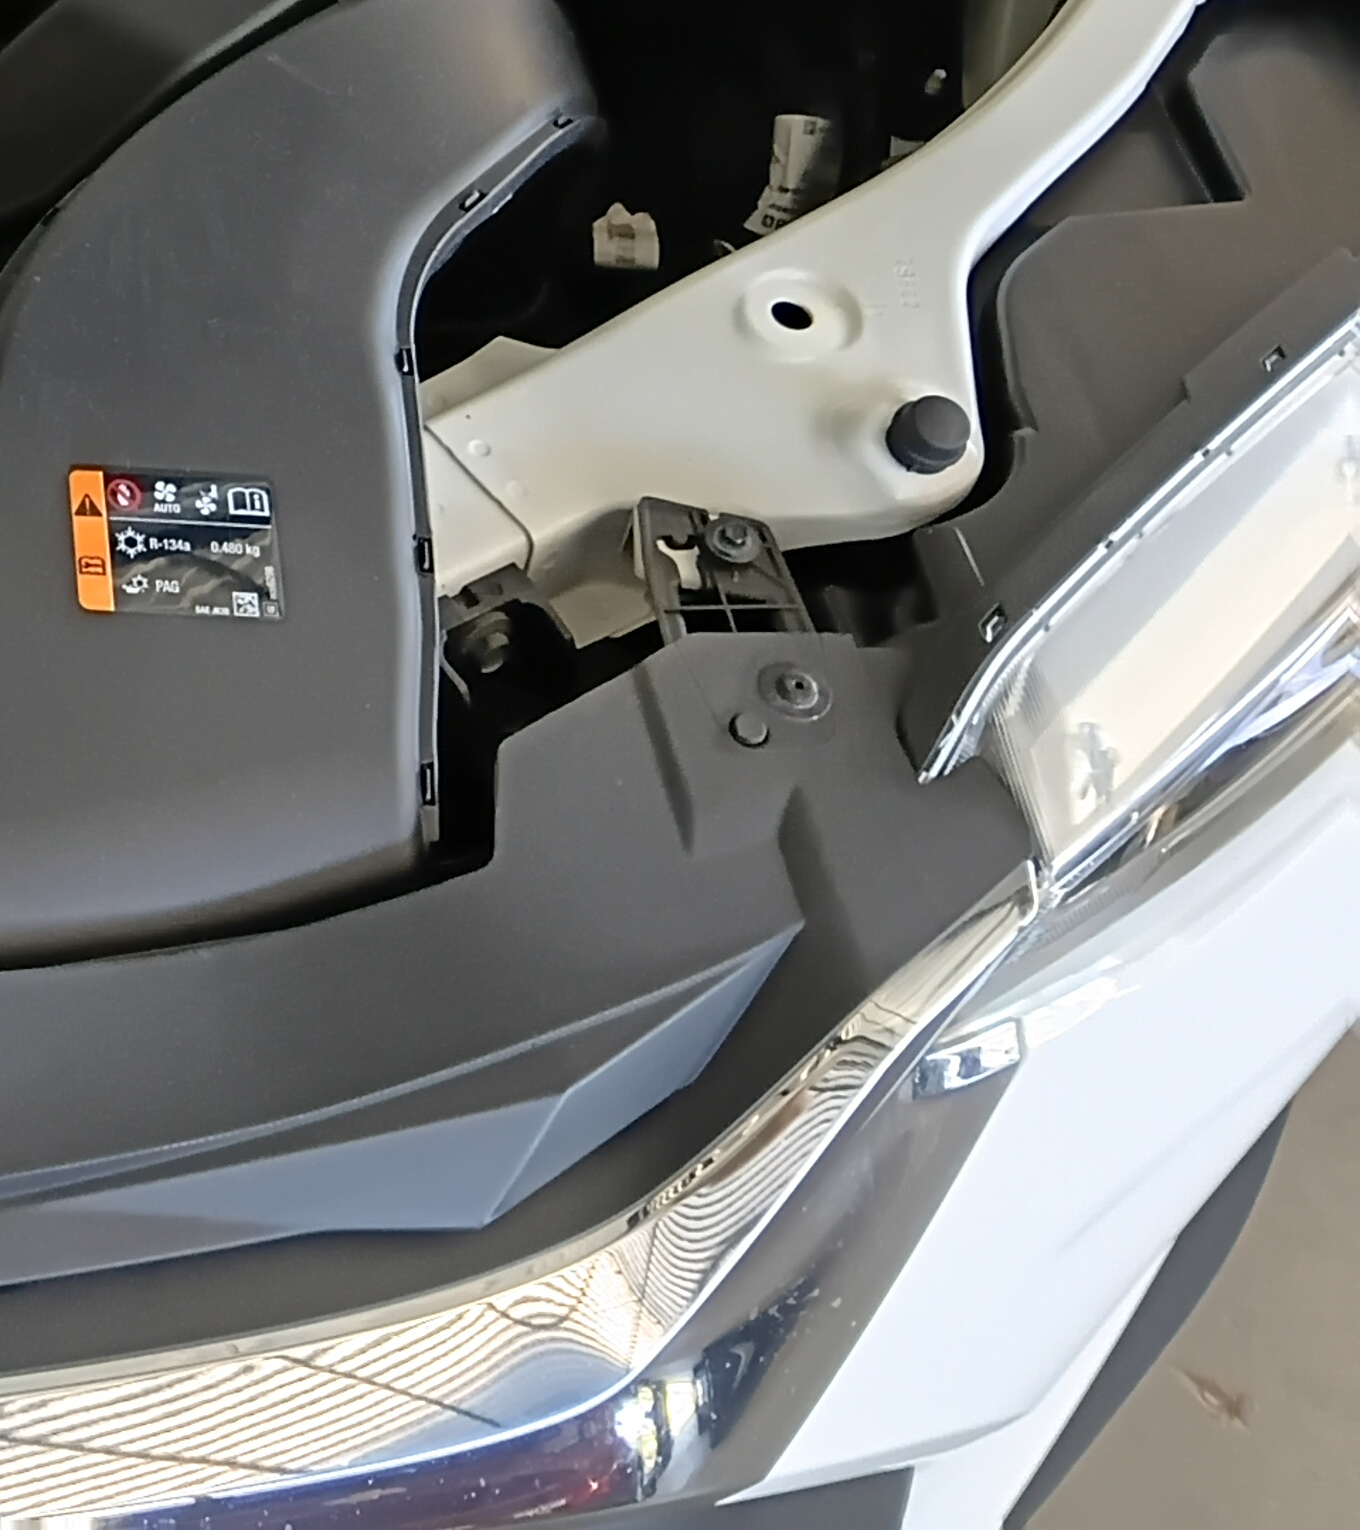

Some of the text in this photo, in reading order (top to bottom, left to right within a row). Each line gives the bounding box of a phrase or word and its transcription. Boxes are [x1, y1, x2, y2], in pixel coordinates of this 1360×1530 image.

[153, 503, 181, 513] AUTO
[149, 537, 191, 552] R-134a
[245, 543, 260, 558] kg
[155, 579, 180, 593] PAG
